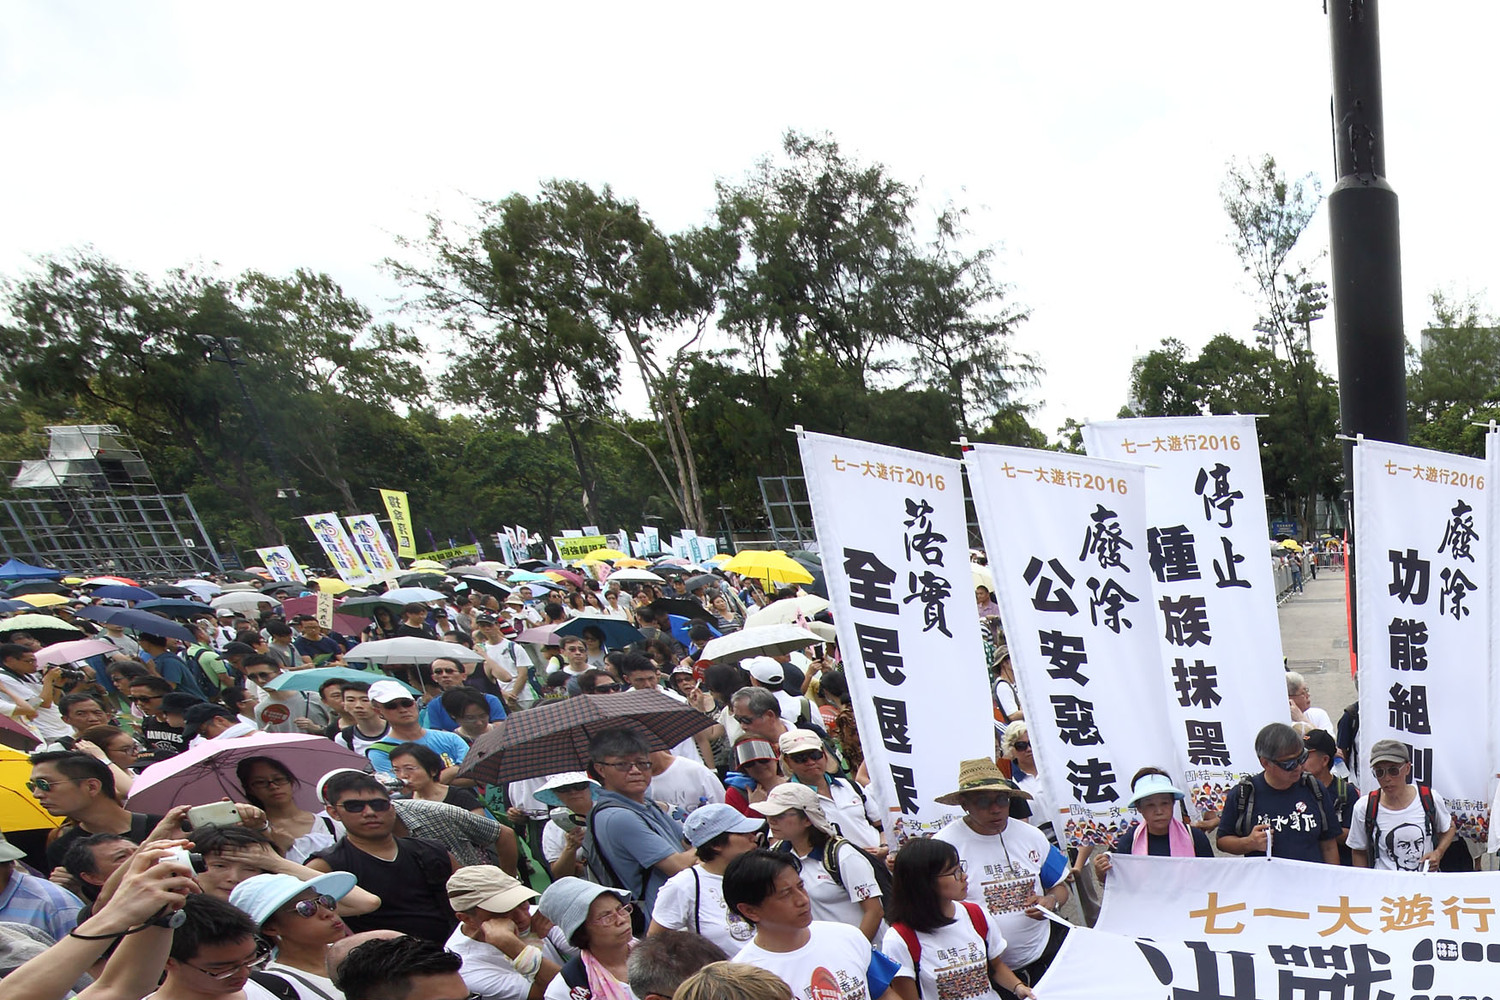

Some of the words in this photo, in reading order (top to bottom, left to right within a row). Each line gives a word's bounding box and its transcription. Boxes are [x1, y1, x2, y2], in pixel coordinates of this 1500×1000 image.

[832, 455, 945, 491] 七一大遊行2016
[1001, 462, 1128, 495] 七一大遊行2016
[1121, 434, 1241, 454] 七一大遊行2016
[1385, 459, 1485, 490] 七一大遊行2016
[903, 498, 953, 639] 落實
[1078, 504, 1140, 634] 廢除
[1194, 463, 1252, 589] 停止
[1438, 499, 1479, 620] 廢除
[1021, 556, 1120, 804] 公安惡法
[1146, 525, 1232, 767] 種族抹黑
